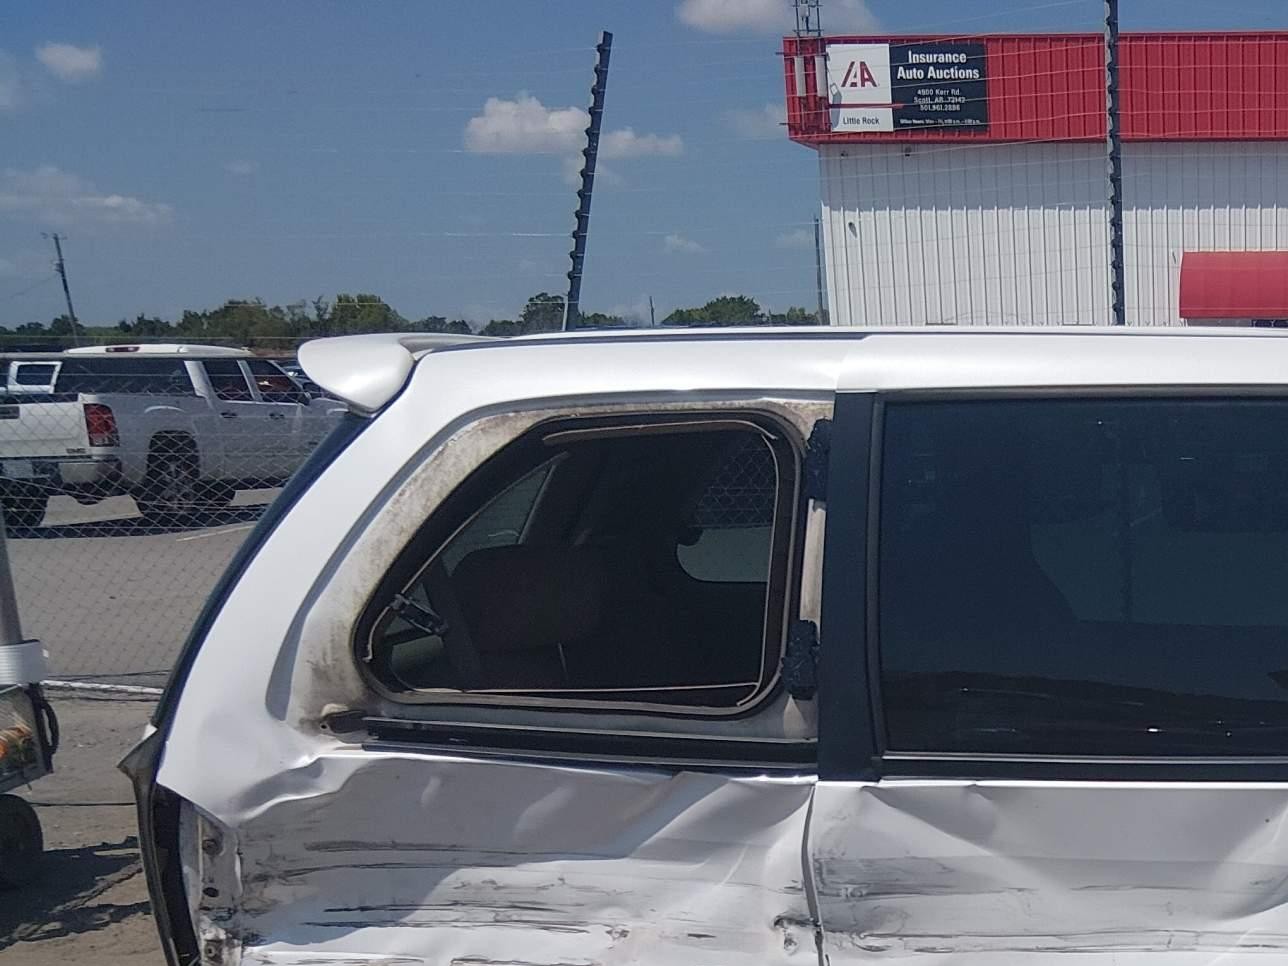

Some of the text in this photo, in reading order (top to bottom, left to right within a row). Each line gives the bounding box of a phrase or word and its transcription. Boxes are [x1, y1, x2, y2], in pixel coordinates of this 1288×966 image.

[908, 50, 967, 64] Insurance
[897, 66, 980, 80] Auto Auctions
[843, 116, 880, 125] Little Rock
